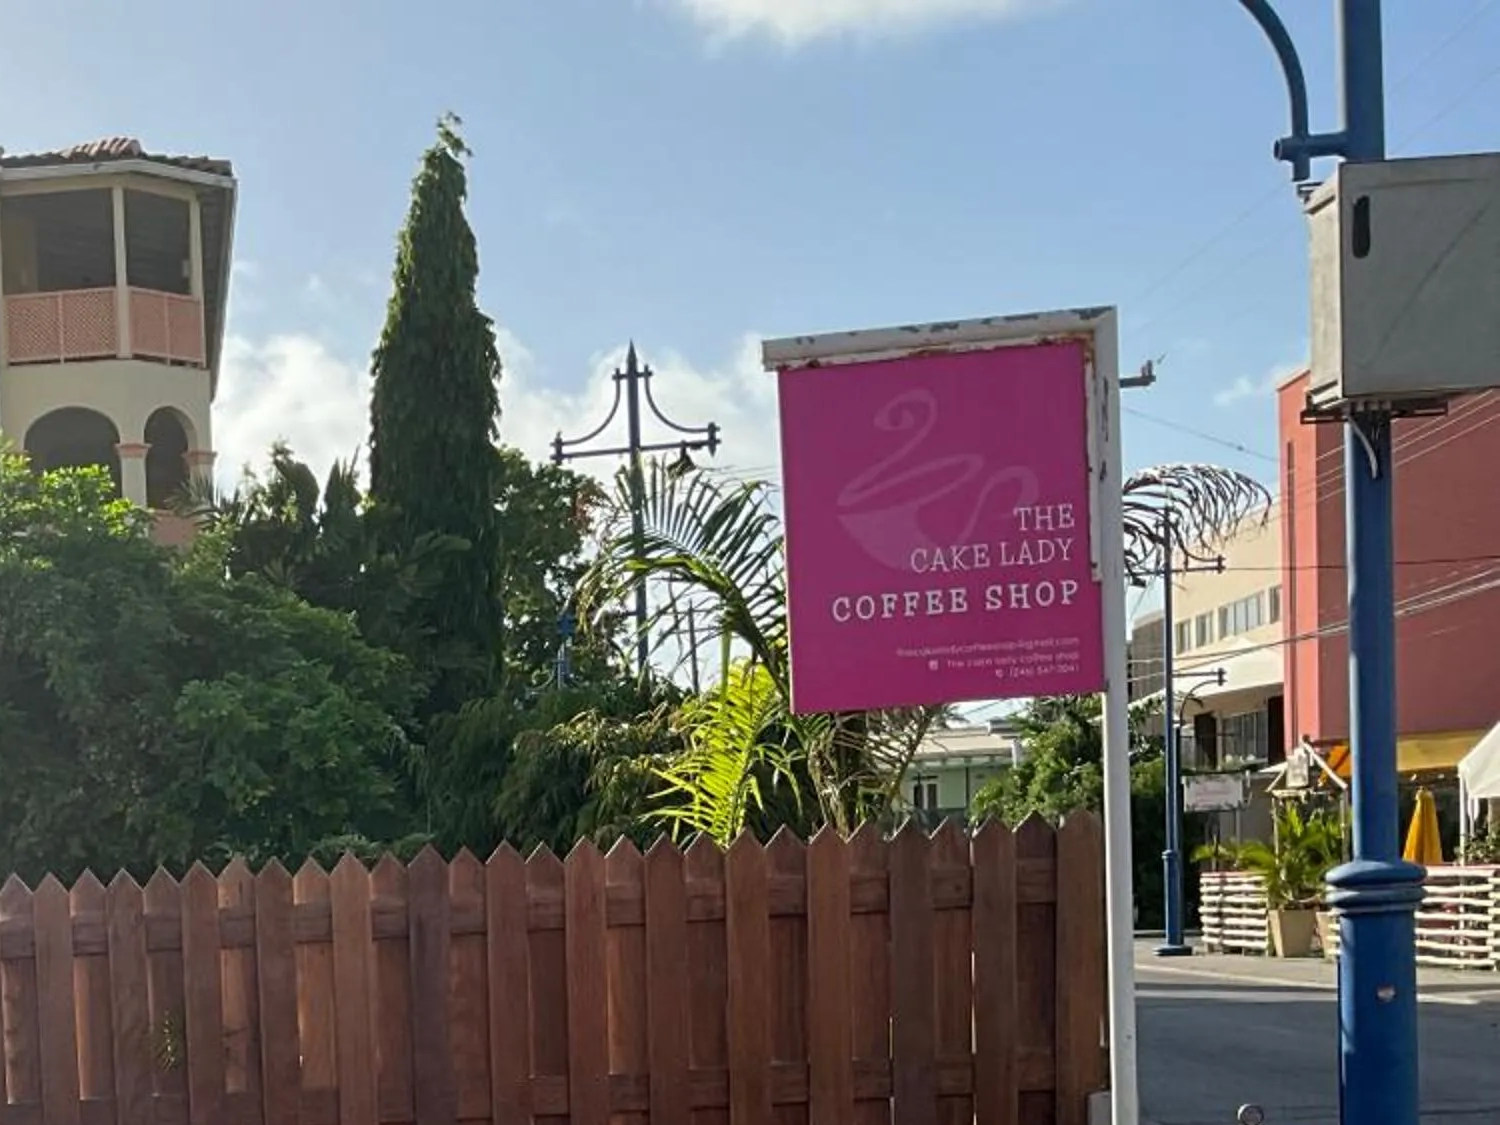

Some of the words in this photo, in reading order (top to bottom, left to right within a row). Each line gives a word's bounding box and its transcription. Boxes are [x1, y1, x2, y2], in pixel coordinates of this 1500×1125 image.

[1013, 503, 1076, 531] THE
[911, 543, 991, 573] CAKE
[1000, 537, 1075, 567] LADY
[832, 586, 968, 622] COFFEE
[985, 580, 1078, 610] SHOP
